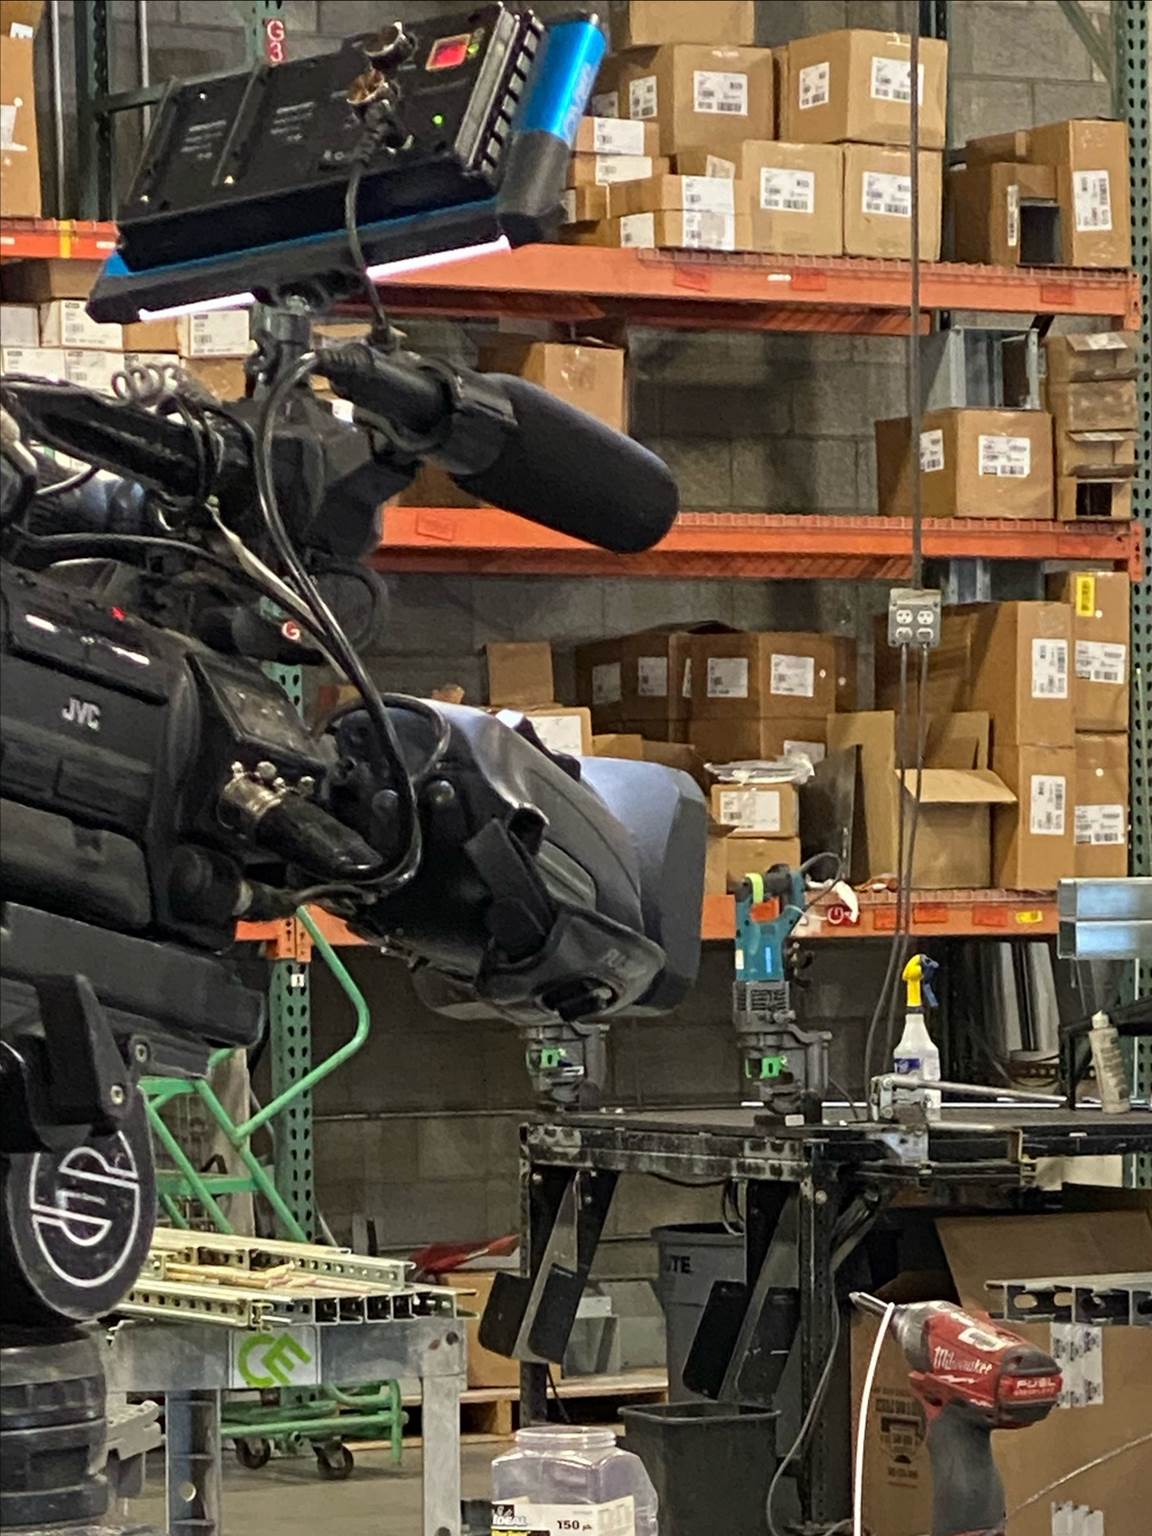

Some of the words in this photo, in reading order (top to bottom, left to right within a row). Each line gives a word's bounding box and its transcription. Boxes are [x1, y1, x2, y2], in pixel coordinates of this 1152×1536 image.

[61, 697, 101, 730] JVC
[932, 1345, 993, 1375] Milwaukee
[1016, 1377, 1056, 1389] FUEL
[492, 1515, 528, 1527] IDEAL
[556, 1519, 581, 1530] 150
